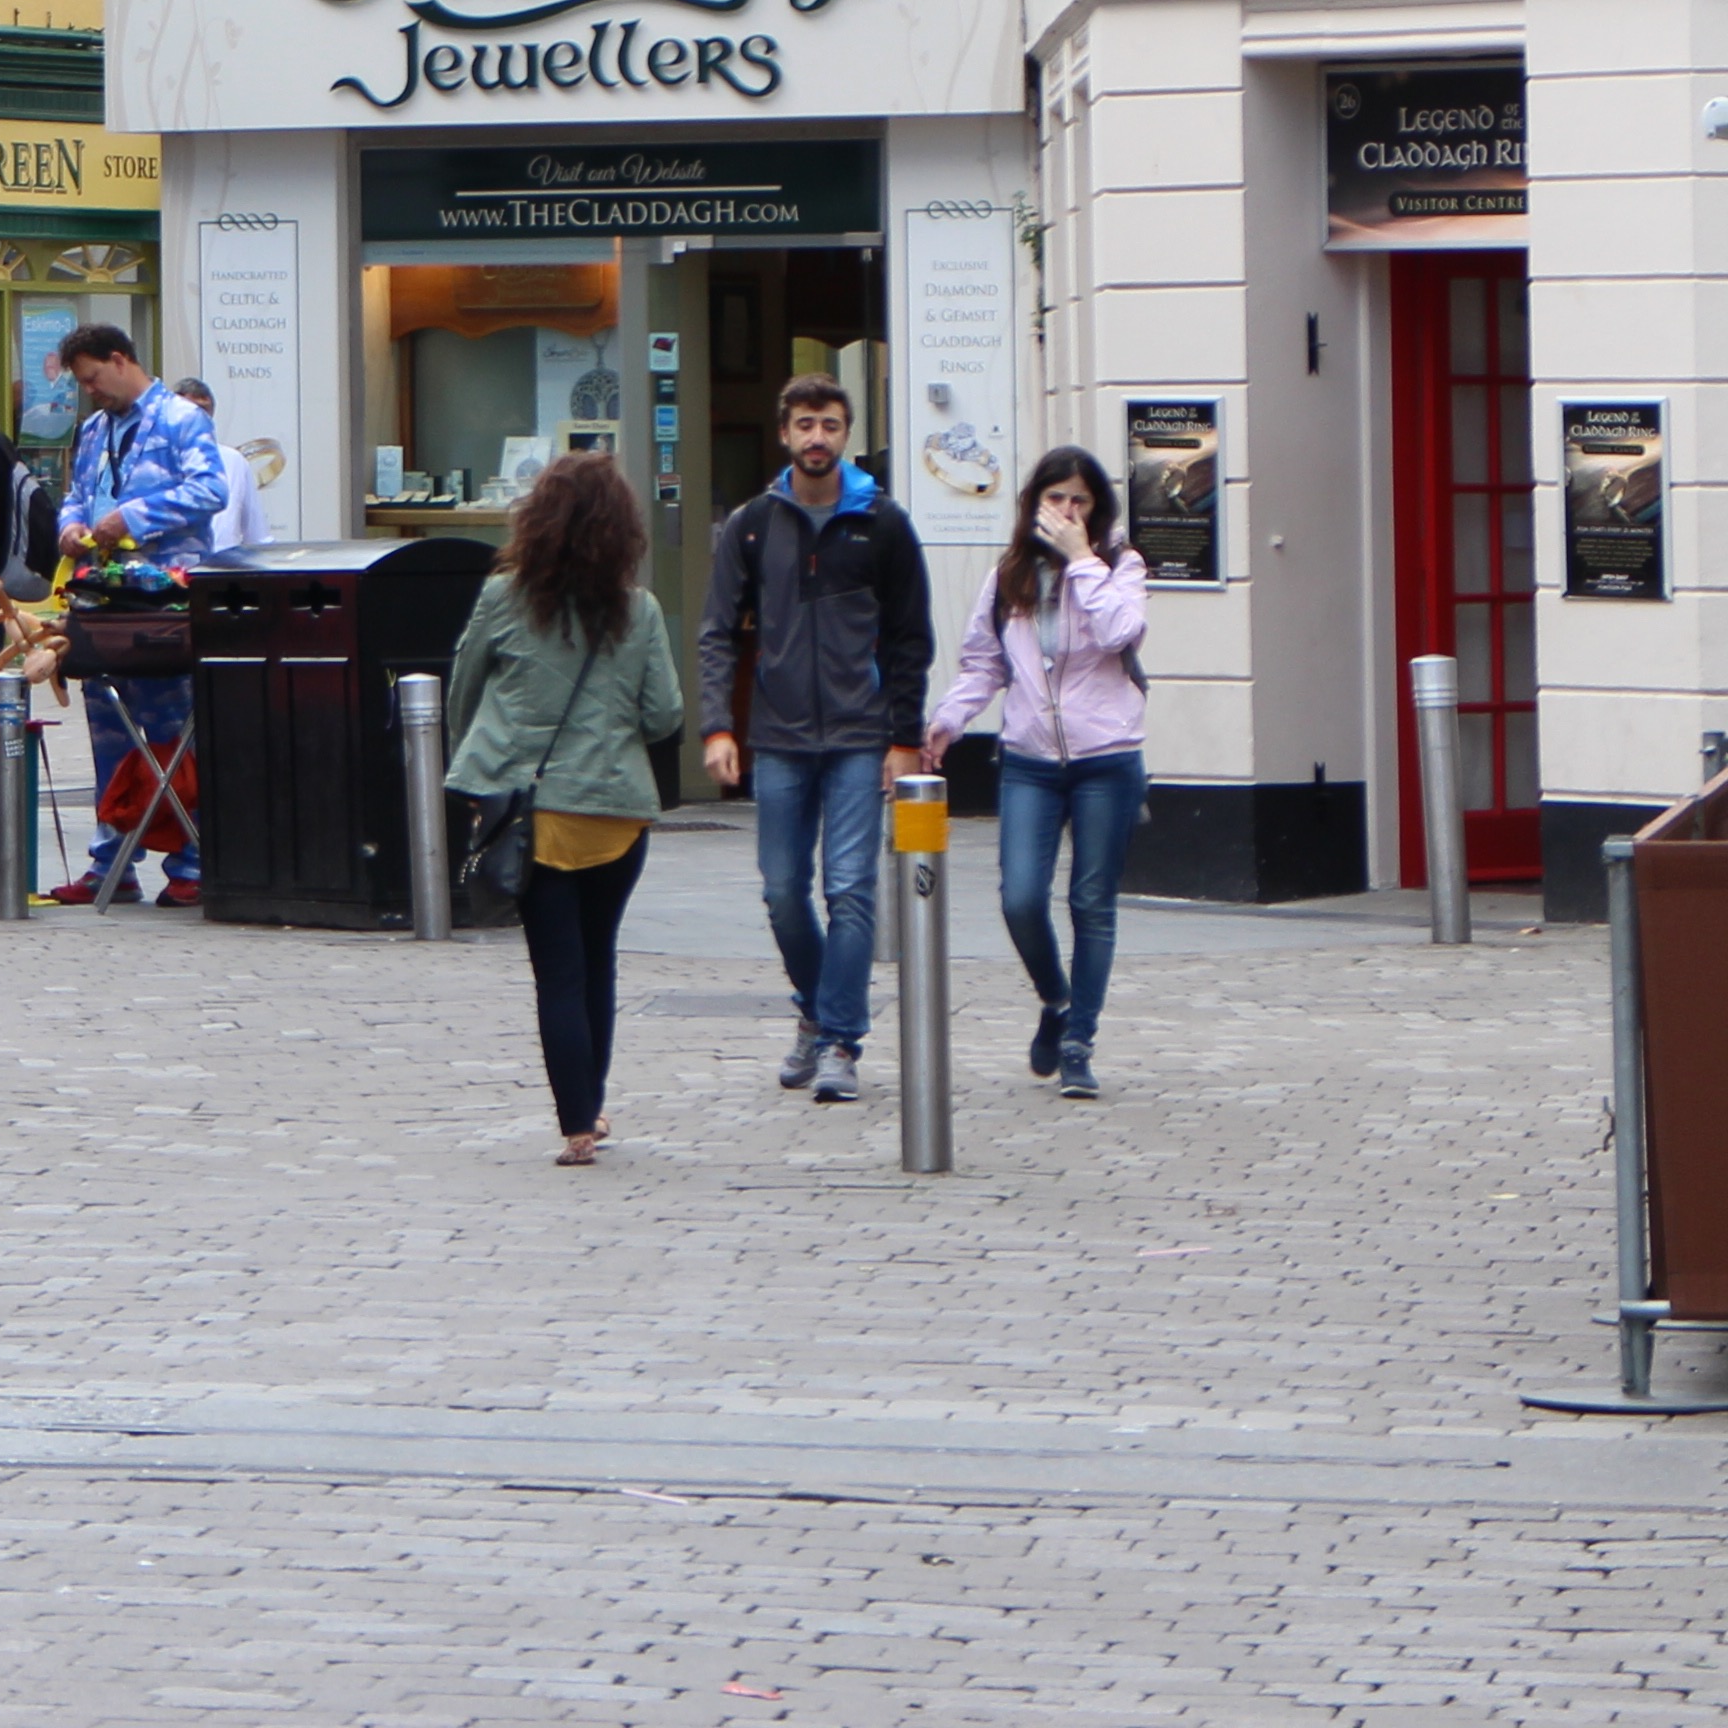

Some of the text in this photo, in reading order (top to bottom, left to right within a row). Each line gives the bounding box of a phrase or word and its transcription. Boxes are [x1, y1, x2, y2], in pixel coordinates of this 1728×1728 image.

[329, 18, 784, 109] Jewellers
[102, 153, 158, 180] STORE
[527, 154, 709, 187] Visit our Website
[1396, 195, 1524, 211] VISITOR CENTRE
[932, 259, 989, 272] EXCLUSIVE
[211, 269, 288, 282] HANDCRAFTED
[924, 283, 999, 298] DIAMOND
[219, 292, 280, 306] CELTIC &
[926, 308, 998, 323] & GEMSET
[212, 316, 287, 331] CLADDAGH
[216, 341, 284, 355] WEDDING
[921, 334, 1002, 348] CLADDAGH
[228, 365, 273, 379] BANDS
[940, 360, 985, 373] RINGS
